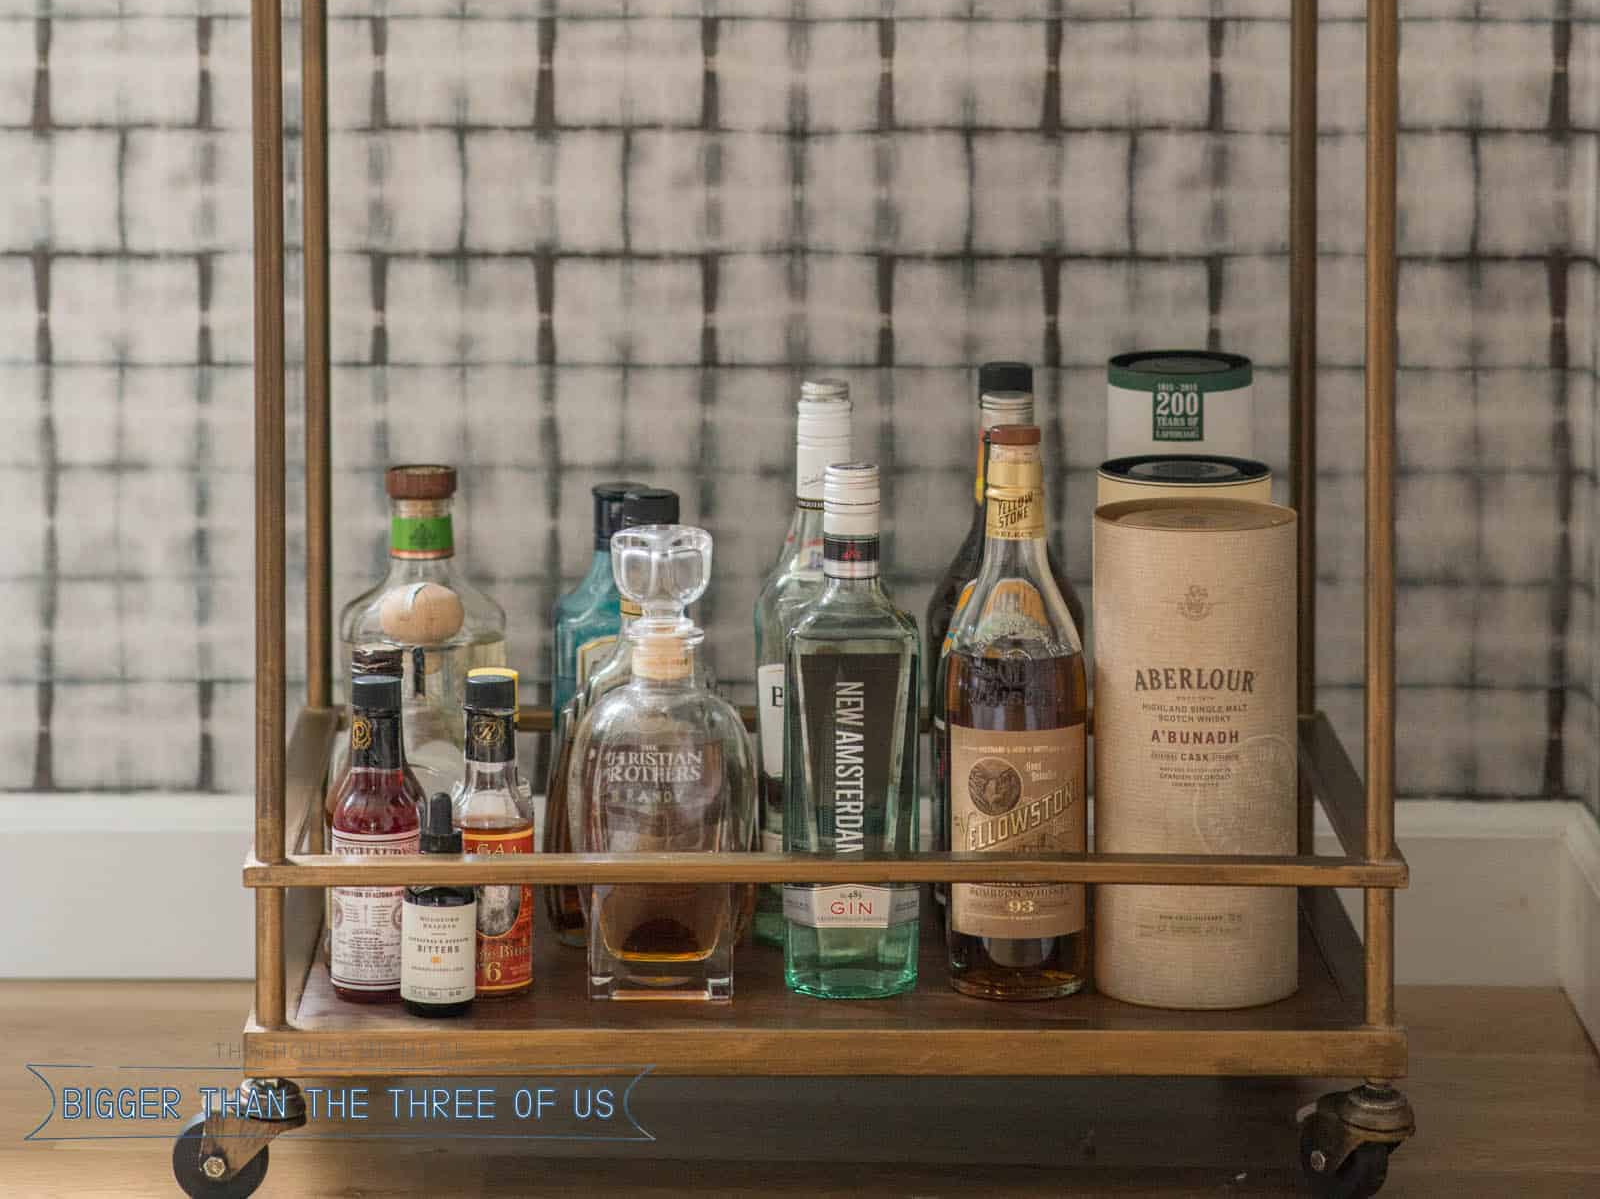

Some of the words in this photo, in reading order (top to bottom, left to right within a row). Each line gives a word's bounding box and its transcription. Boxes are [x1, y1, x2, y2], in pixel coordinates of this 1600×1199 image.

[1156, 391, 1199, 415] 200
[999, 506, 1029, 528] STONE
[1135, 667, 1255, 694] ABERLOUR
[836, 682, 865, 726] NEW
[1191, 705, 1224, 713] SINGLE
[1226, 704, 1249, 712] MALT
[1158, 714, 1194, 722] SCOTCH
[1197, 714, 1231, 722] WHISKY
[1151, 729, 1239, 744] A'BUNADH
[1180, 753, 1209, 762] CASK
[960, 781, 1077, 852] YELLOWSTON
[830, 901, 873, 915] GIN
[1008, 900, 1035, 914] 93
[485, 961, 503, 982] 6
